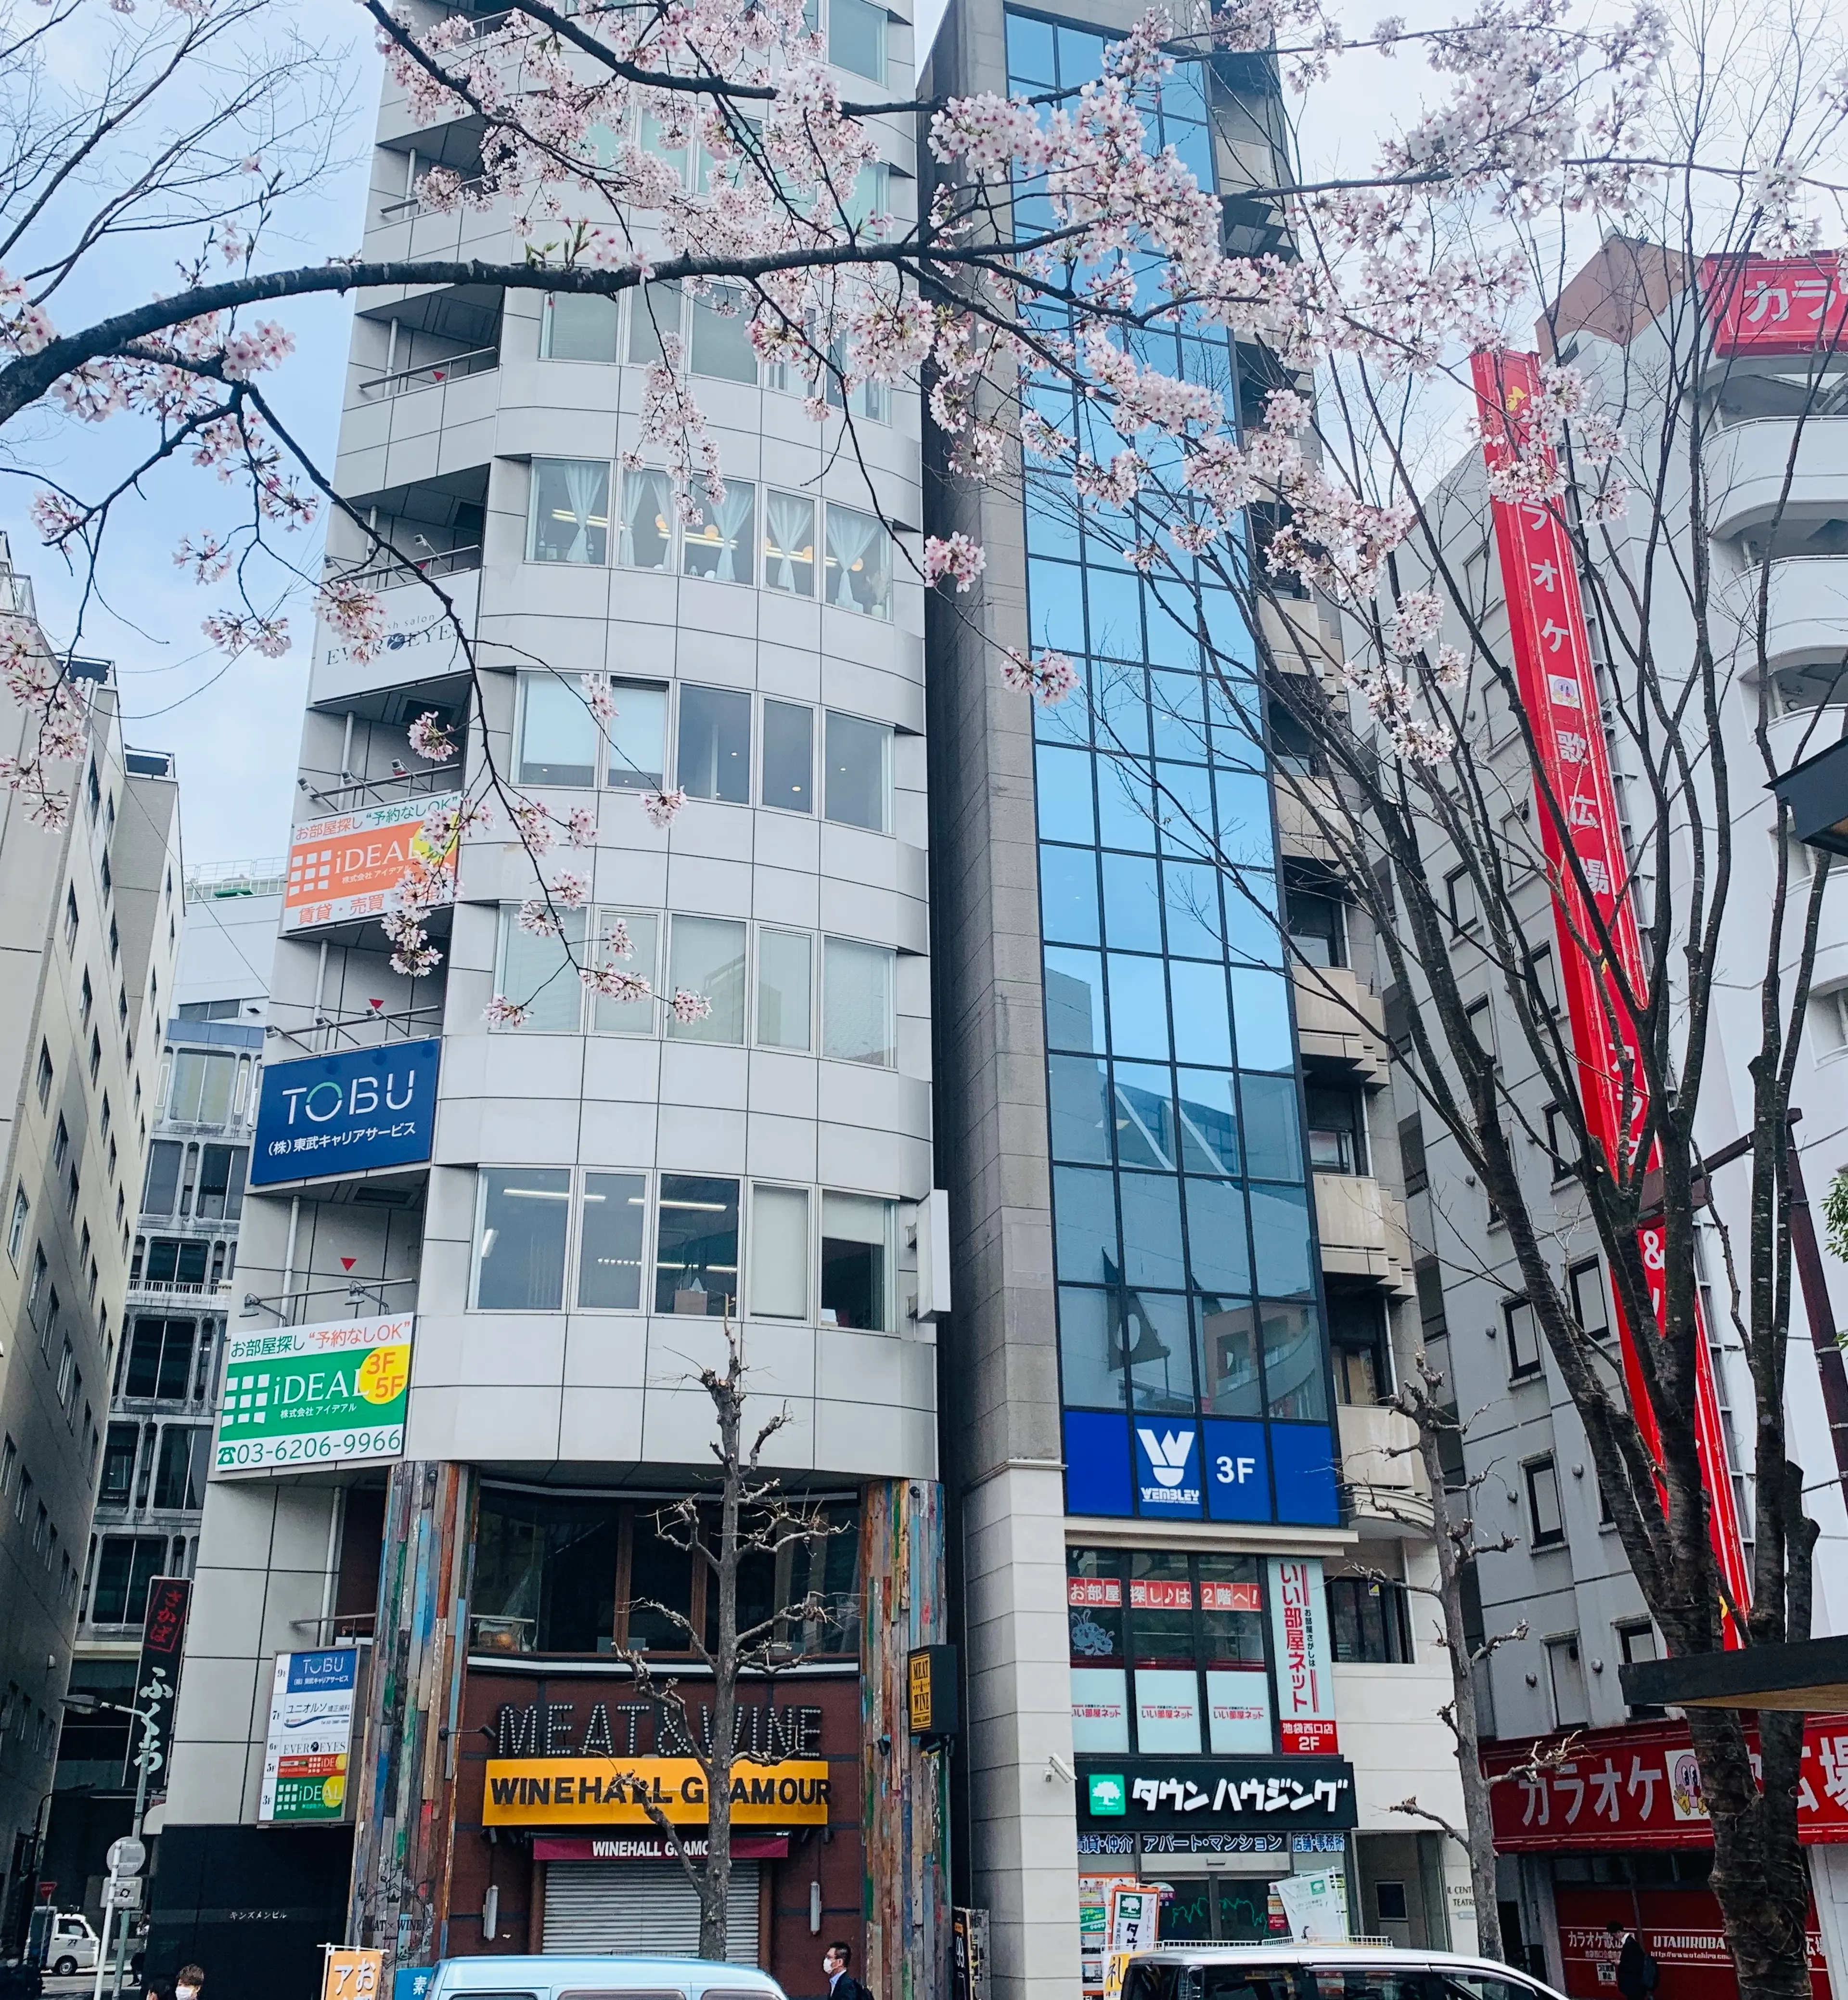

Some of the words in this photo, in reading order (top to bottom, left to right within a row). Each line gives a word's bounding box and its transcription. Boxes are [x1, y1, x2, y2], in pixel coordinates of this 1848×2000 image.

[1744, 281, 1837, 323] カラ
[405, 614, 435, 626] salon
[295, 817, 363, 840] お部屋探し
[334, 837, 418, 874] iDEAL
[342, 871, 372, 884] 株式会社
[282, 1070, 415, 1124] TOBU
[268, 1122, 416, 1156] (株)東武キャリアサービス
[231, 1335, 305, 1358] お部屋探し
[366, 1352, 396, 1375] 3F
[272, 1368, 370, 1406] iDEAL
[375, 1375, 405, 1399] 5F
[280, 1407, 313, 1419] 株式会社
[316, 1403, 357, 1416] アイデアル
[237, 1429, 401, 1464] 03-6206-9966
[1216, 1456, 1256, 1484] 3F
[1140, 1487, 1200, 1501] WEMBLEY
[1070, 1585, 1121, 1602] お部屋
[1280, 1563, 1308, 1713] いい部屋ネット
[1304, 1609, 1316, 1667] お部屋さがしは
[277, 1668, 286, 1678] 9F
[303, 1656, 344, 1674] TOBU
[913, 1660, 929, 1681] MEAT
[286, 1702, 328, 1714] ユニオルソ
[913, 1692, 929, 1712] WINE
[1142, 1709, 1193, 1719] いい部屋ネット
[1213, 1710, 1264, 1720] いい部屋ネット
[1282, 1722, 1334, 1735] 池袋西口店
[283, 1743, 310, 1755] EVER
[320, 1741, 346, 1753] EYES
[1298, 1736, 1320, 1751] 2F
[267, 1763, 276, 1773] 5F
[262, 1794, 273, 1806] 3F
[298, 1784, 342, 1802] iDEAL
[680, 1777, 832, 1806] GAMOUR
[1132, 1778, 1348, 1813] タウンハウジング
[1519, 1756, 1662, 1826] カラオケ
[592, 1841, 662, 1857] WINEHALL
[1143, 1833, 1283, 1853] アパート・マンション
[1652, 1935, 1726, 1949] UTAHIROBA
